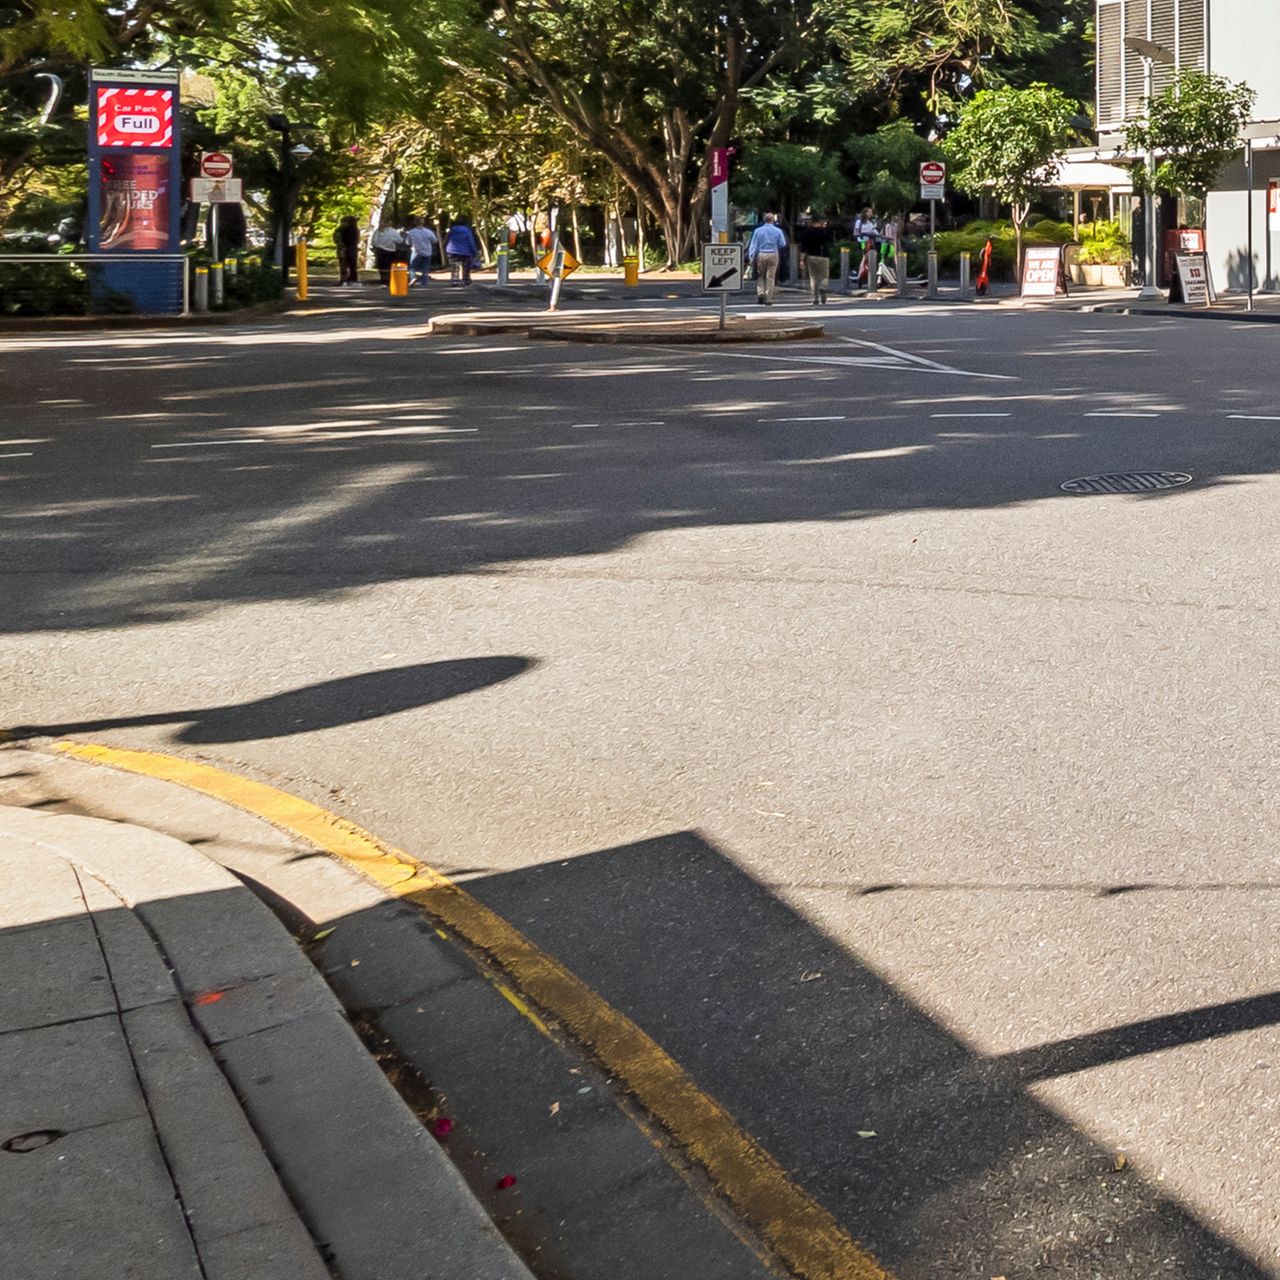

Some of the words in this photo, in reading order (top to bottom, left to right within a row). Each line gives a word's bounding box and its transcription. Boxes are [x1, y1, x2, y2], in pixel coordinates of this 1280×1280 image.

[114, 104, 132, 112] Car
[135, 104, 157, 112] Park
[122, 117, 152, 129] Full
[710, 247, 737, 256] KEEP
[712, 257, 735, 266] LEFT
[1027, 260, 1041, 269] WE
[1041, 260, 1055, 269] ARE
[1026, 269, 1055, 282] OPEN
